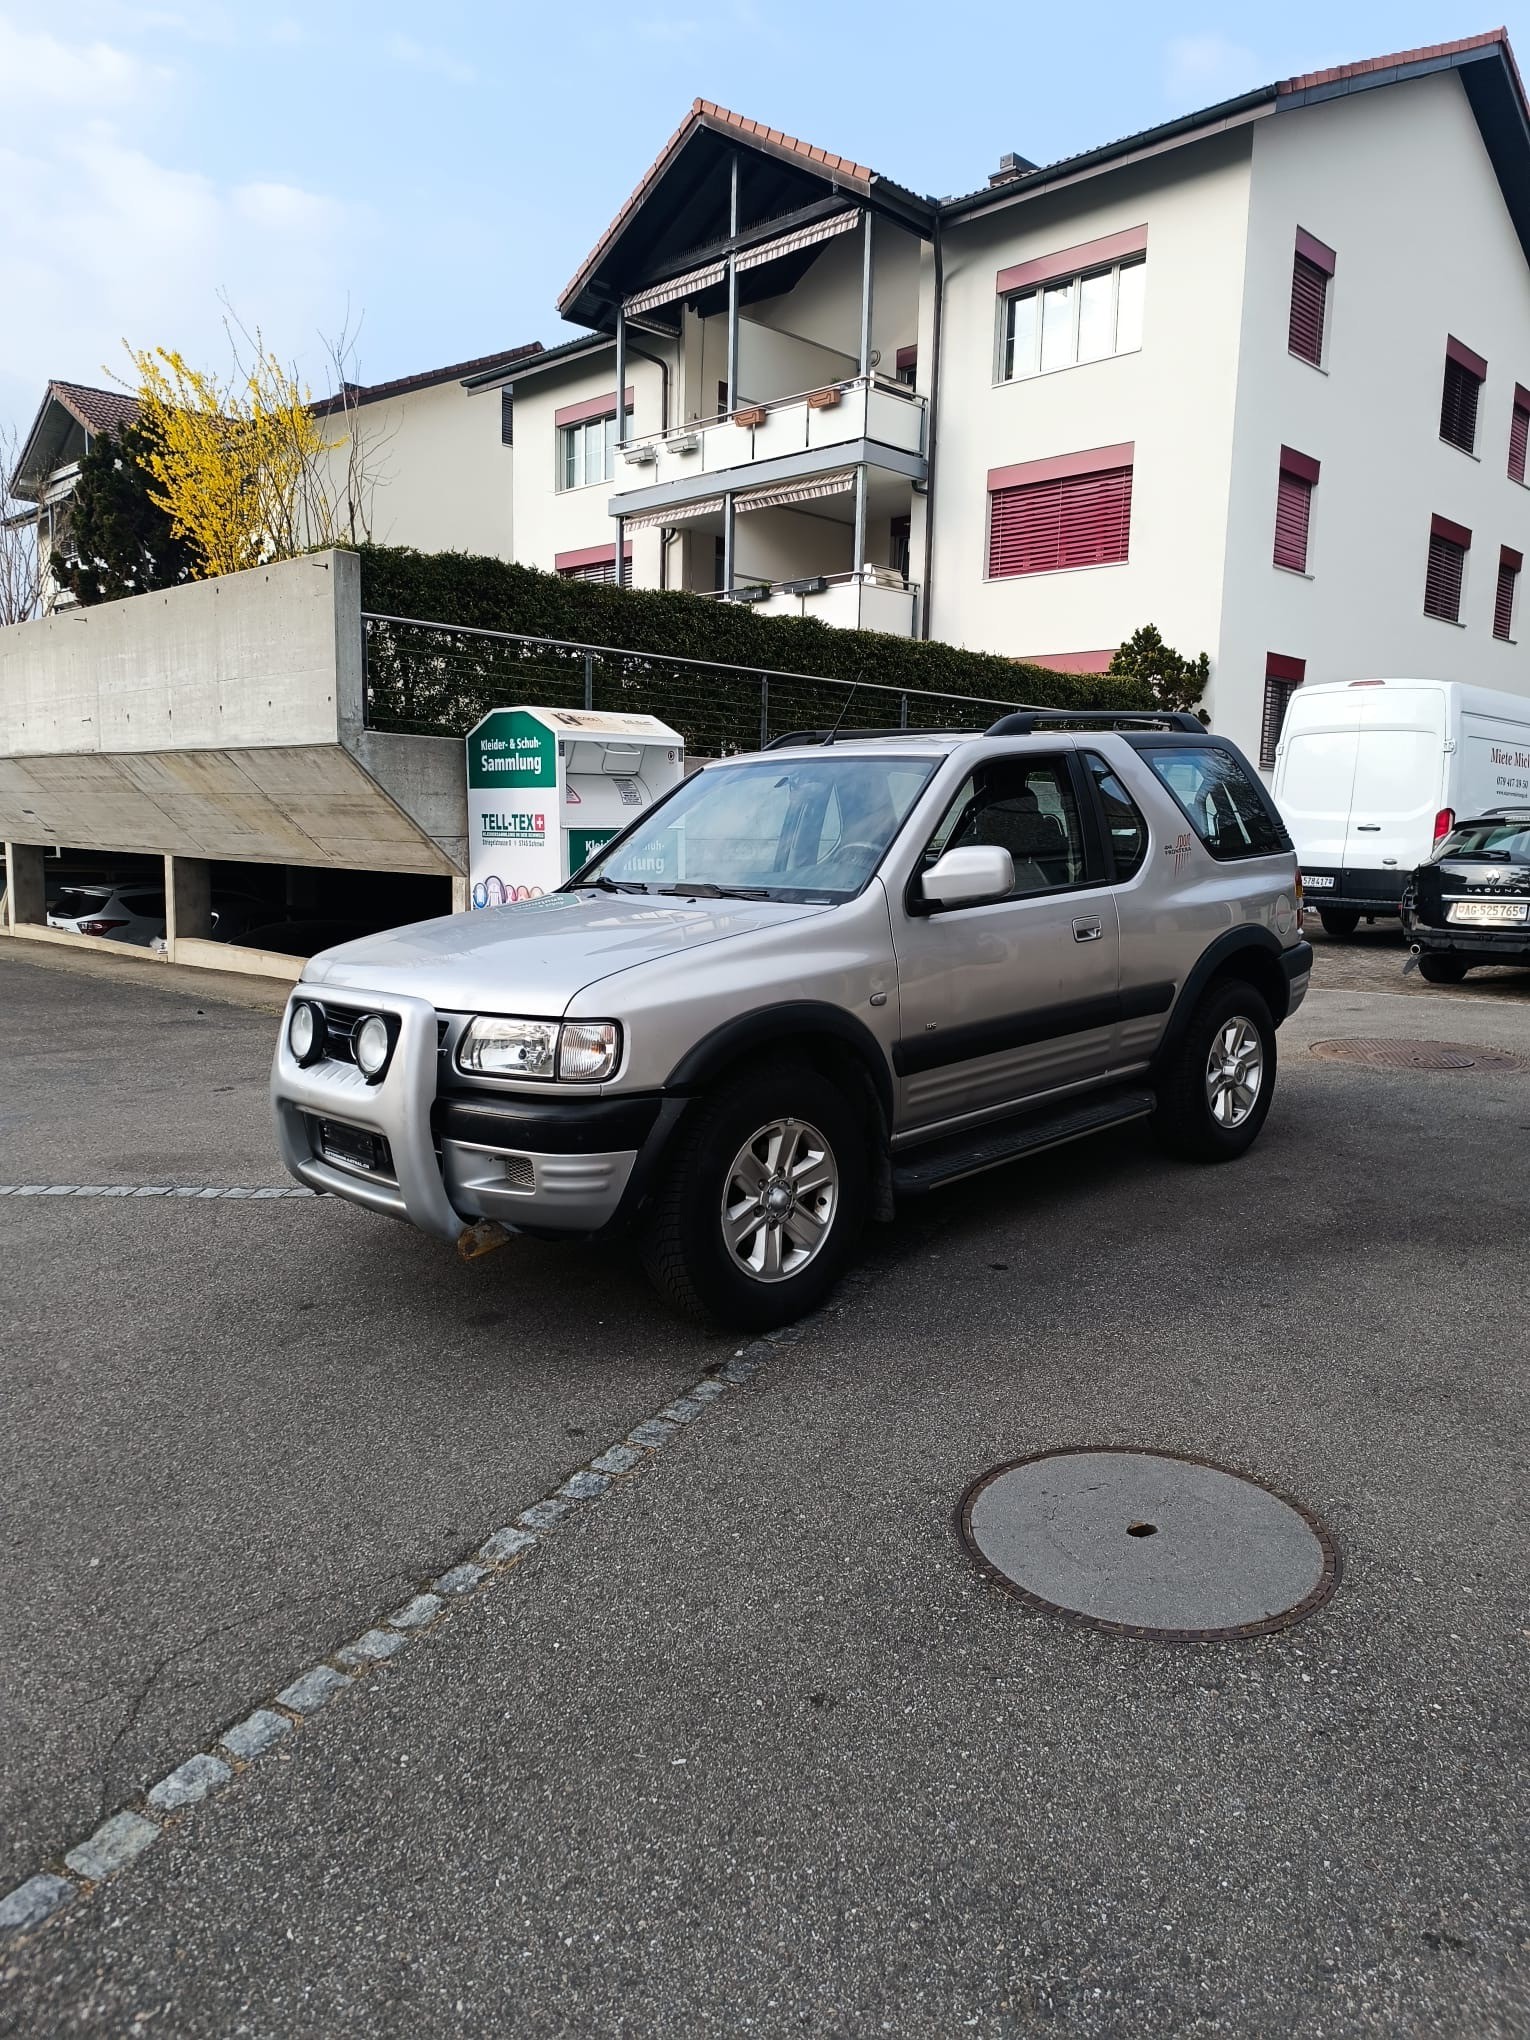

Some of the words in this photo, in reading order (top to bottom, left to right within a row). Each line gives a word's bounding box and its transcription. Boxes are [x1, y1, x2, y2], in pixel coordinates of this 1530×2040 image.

[480, 739, 508, 751] Kleider-
[509, 738, 516, 749] &
[517, 736, 542, 749] Schuh-
[481, 752, 542, 775] Sammlung
[1490, 747, 1513, 766] Miete
